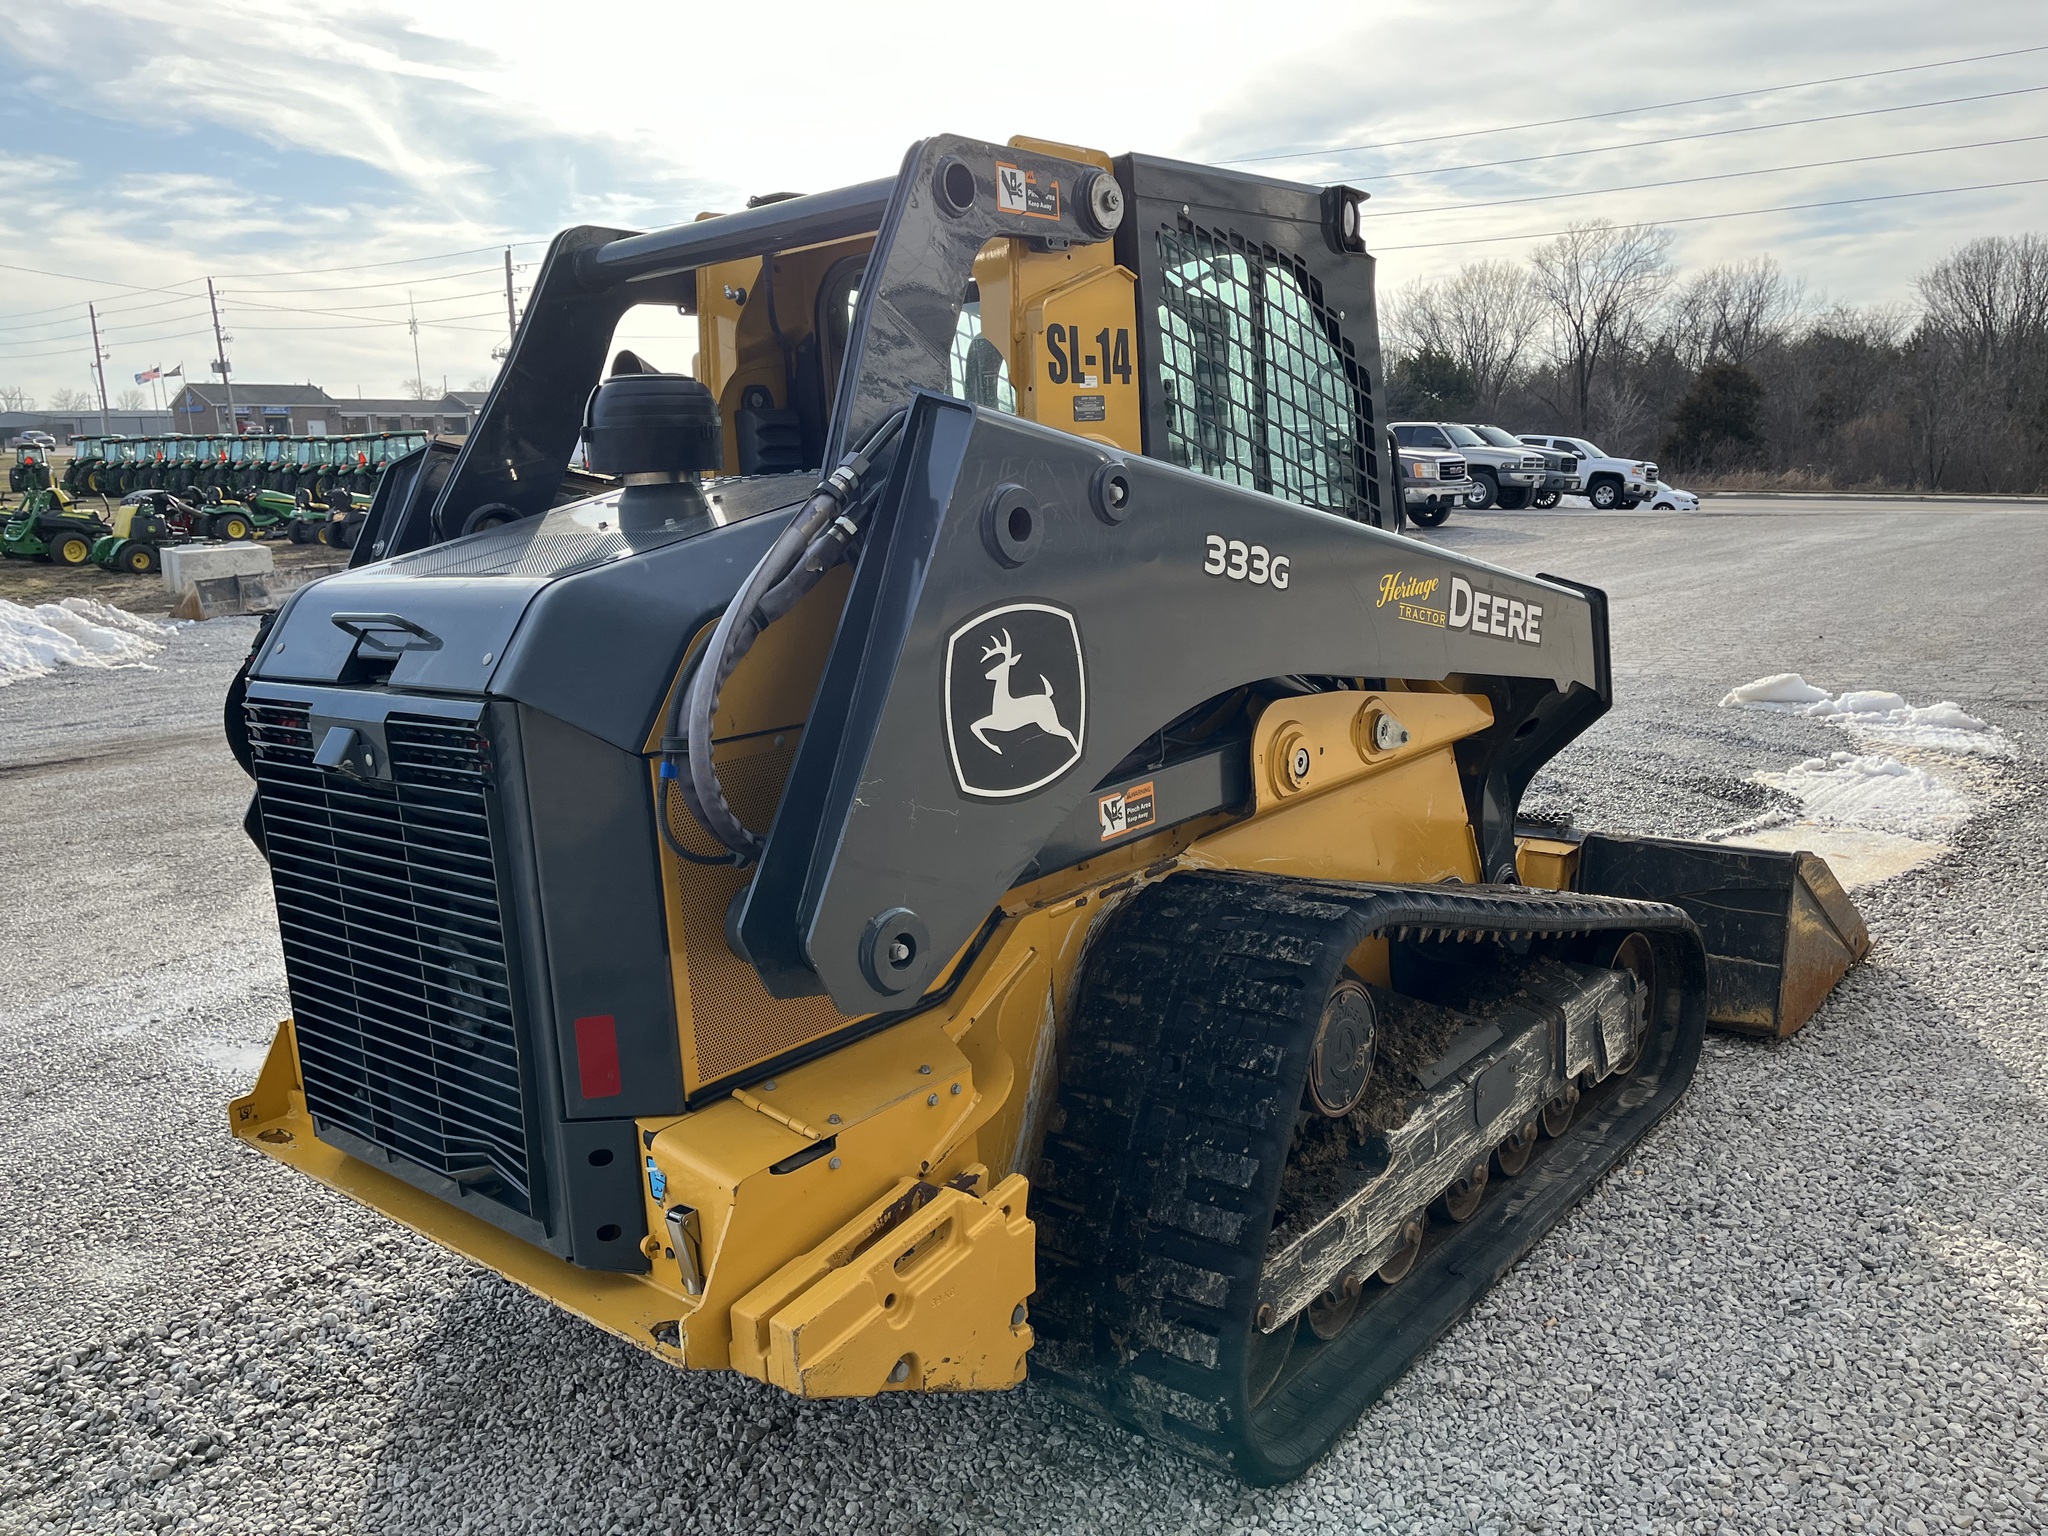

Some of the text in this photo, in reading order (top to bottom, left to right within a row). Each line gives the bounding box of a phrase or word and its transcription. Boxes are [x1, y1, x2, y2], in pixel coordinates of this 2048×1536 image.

[1027, 199, 1053, 211] Keep Away
[1046, 323, 1132, 385] SL-14
[1204, 534, 1290, 589] 333G
[1376, 571, 1440, 608] Heritage
[1399, 604, 1447, 626] TRACTOR
[1449, 577, 1543, 644] DEERE
[1127, 802, 1151, 815] Pinch Area
[1127, 815, 1138, 823] Keep
